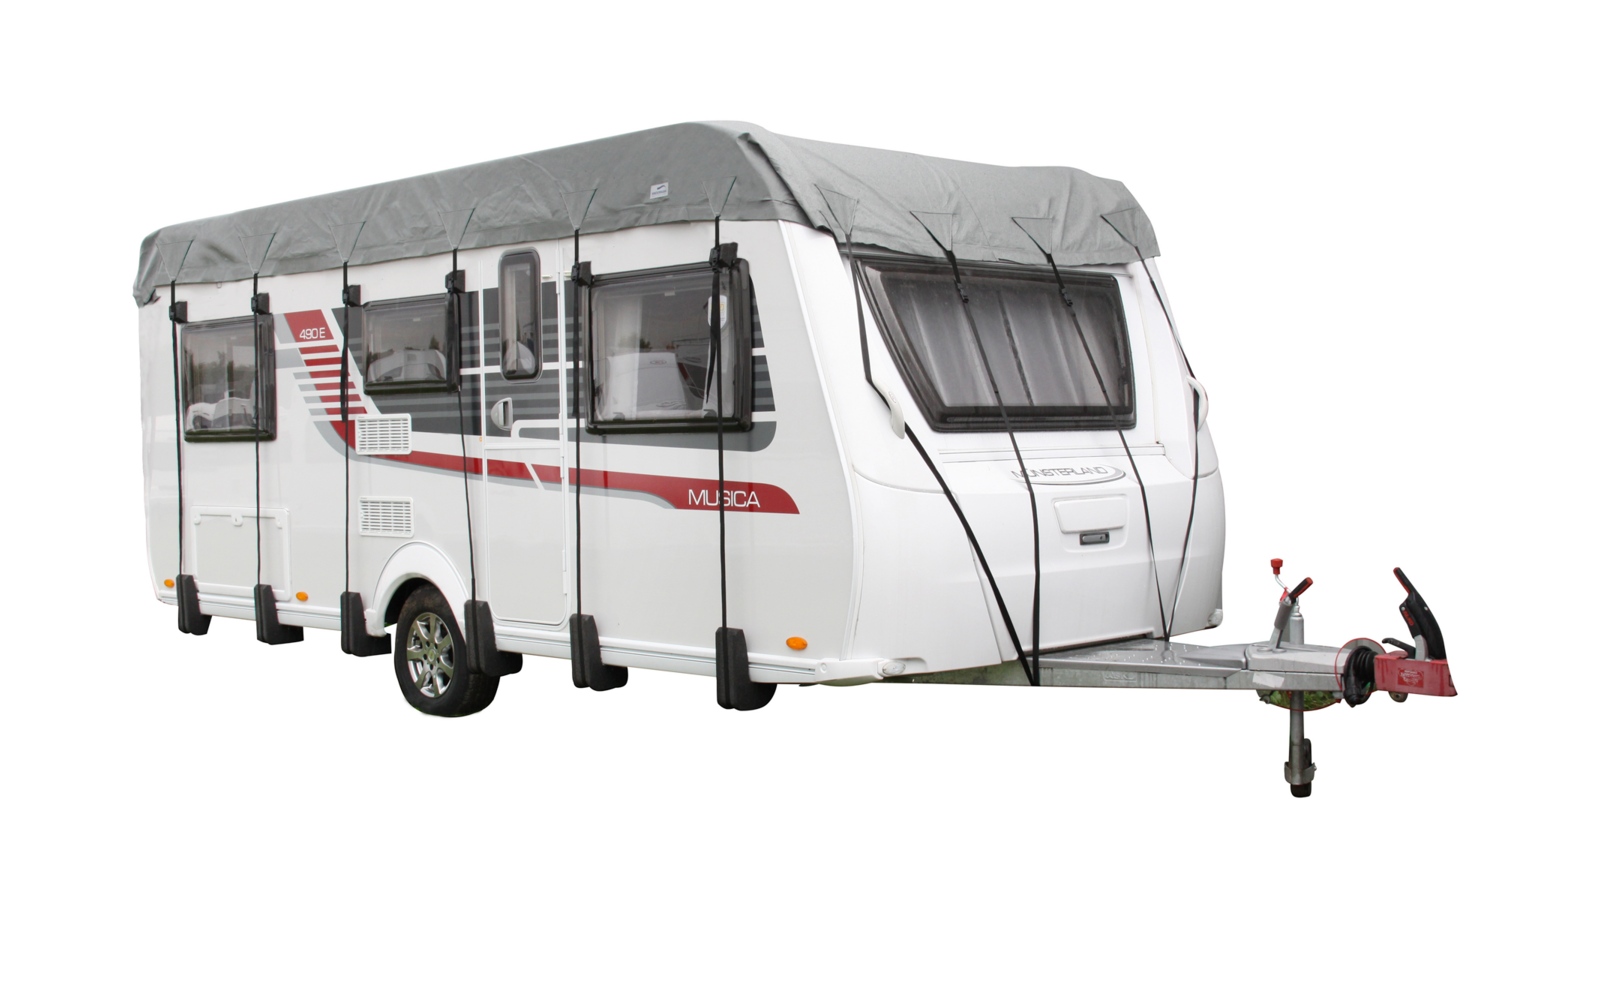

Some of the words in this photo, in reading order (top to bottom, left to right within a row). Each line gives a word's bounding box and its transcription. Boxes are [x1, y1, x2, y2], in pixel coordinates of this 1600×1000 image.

[299, 328, 319, 340] 490
[319, 327, 326, 339] E
[688, 489, 761, 508] MUSICA
